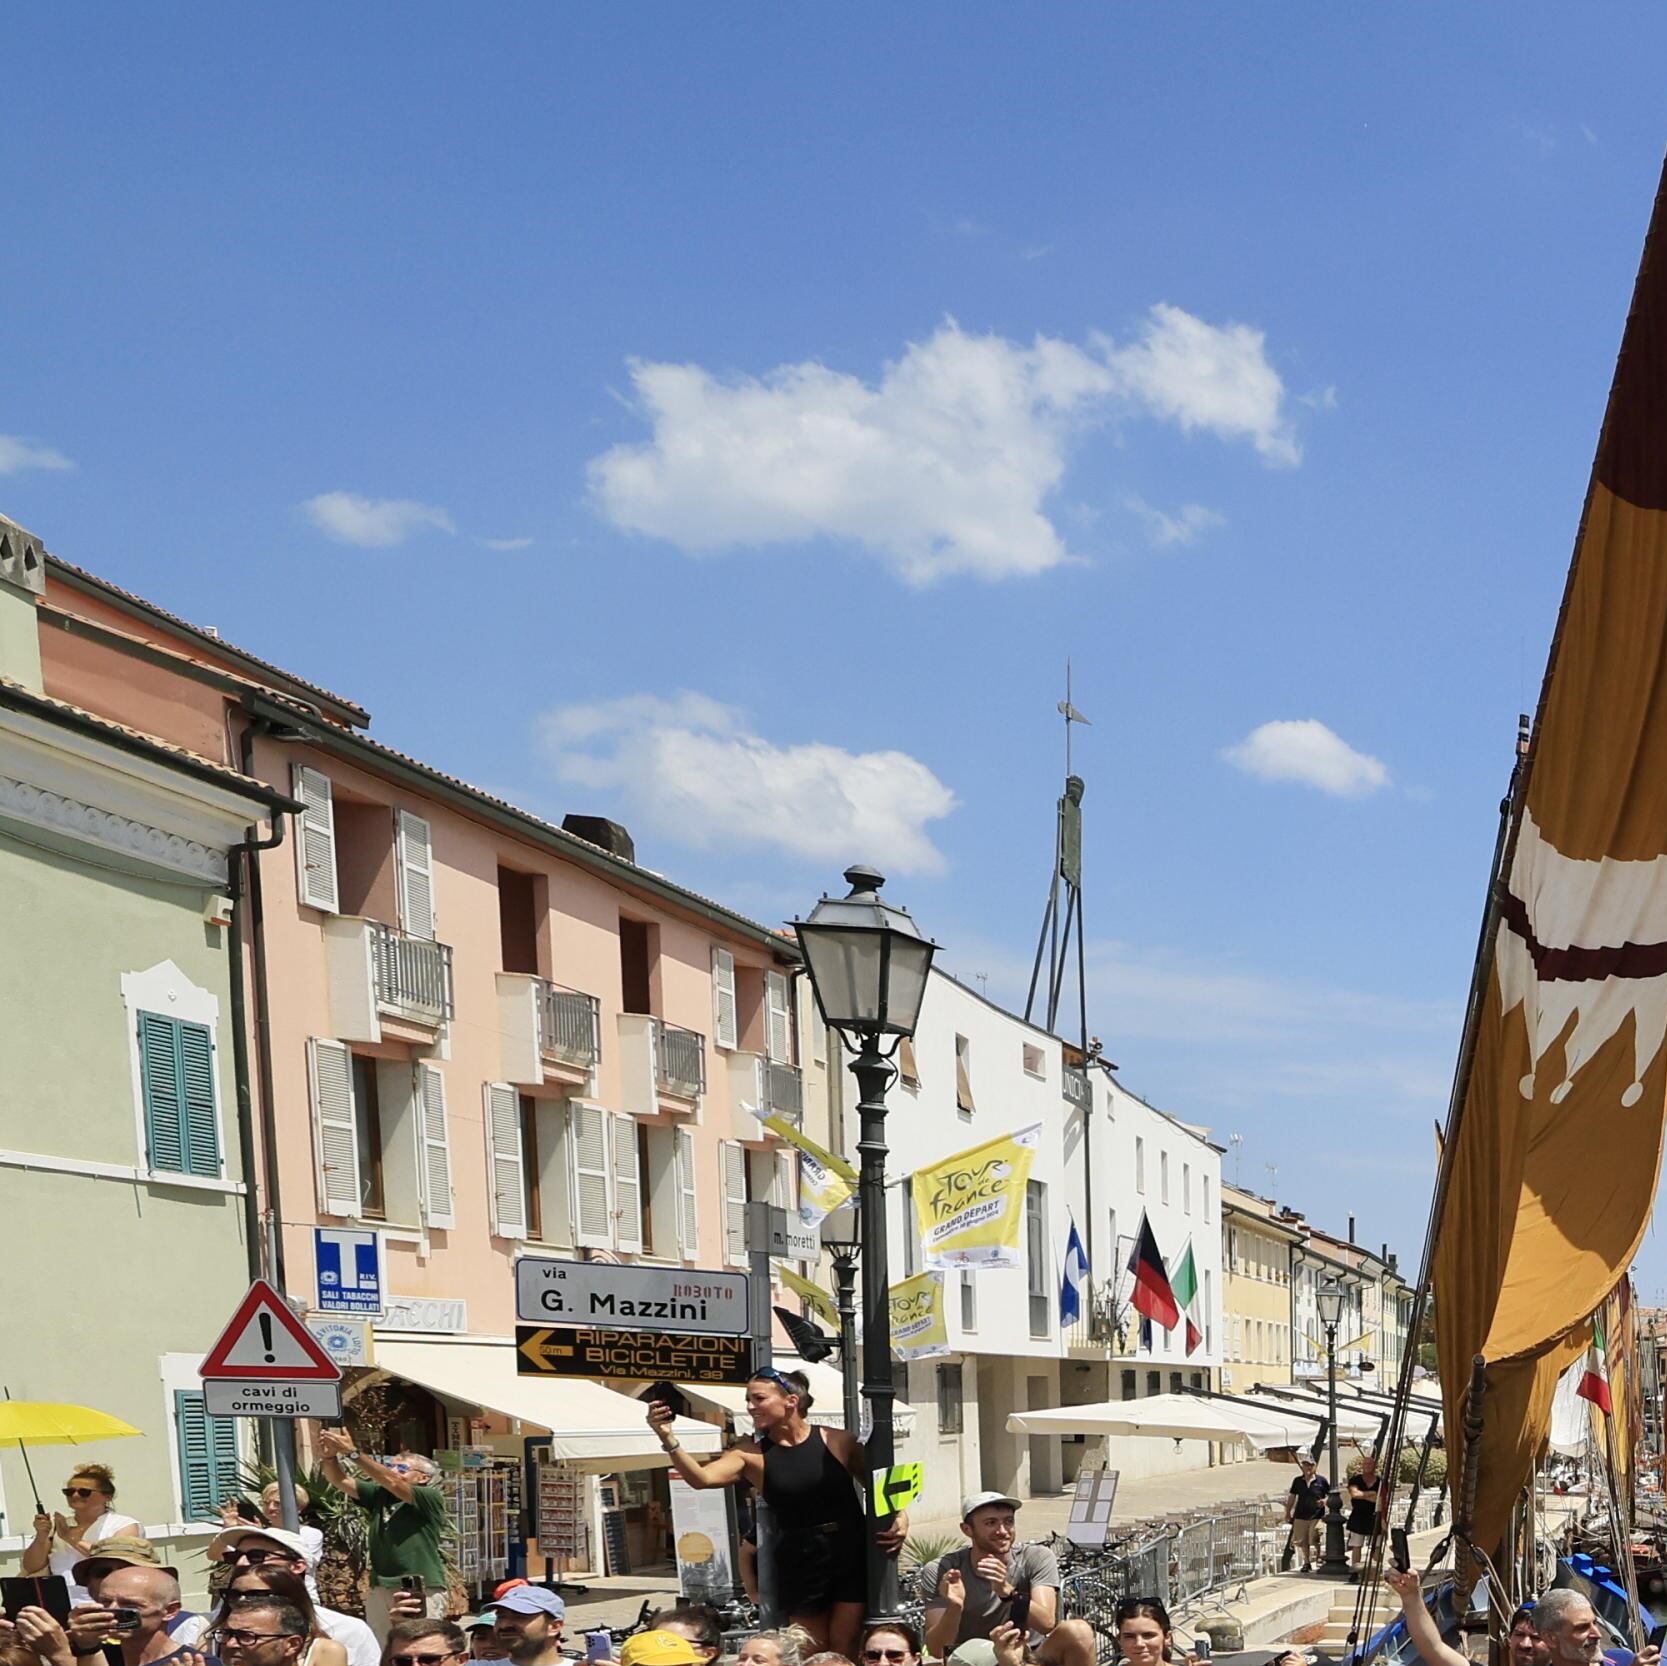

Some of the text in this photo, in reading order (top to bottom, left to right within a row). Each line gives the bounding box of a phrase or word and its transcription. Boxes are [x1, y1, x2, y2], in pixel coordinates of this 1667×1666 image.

[937, 1159, 1003, 1197] TOUR
[934, 1200, 1000, 1236] GRAND DEPART
[773, 1231, 816, 1250] m. moretti
[542, 1267, 567, 1279] via
[321, 1290, 379, 1302] SALI TABACCHI
[541, 1289, 707, 1321] G. Mazzini
[321, 1300, 380, 1312] VALORI BOLLATI
[575, 1329, 744, 1353] RIPARAZIONI
[585, 1347, 736, 1369] BICICLETTE
[600, 1363, 695, 1380] Via Mazzini,
[242, 1387, 297, 1398] cavi di
[232, 1401, 310, 1414] ormeggio
